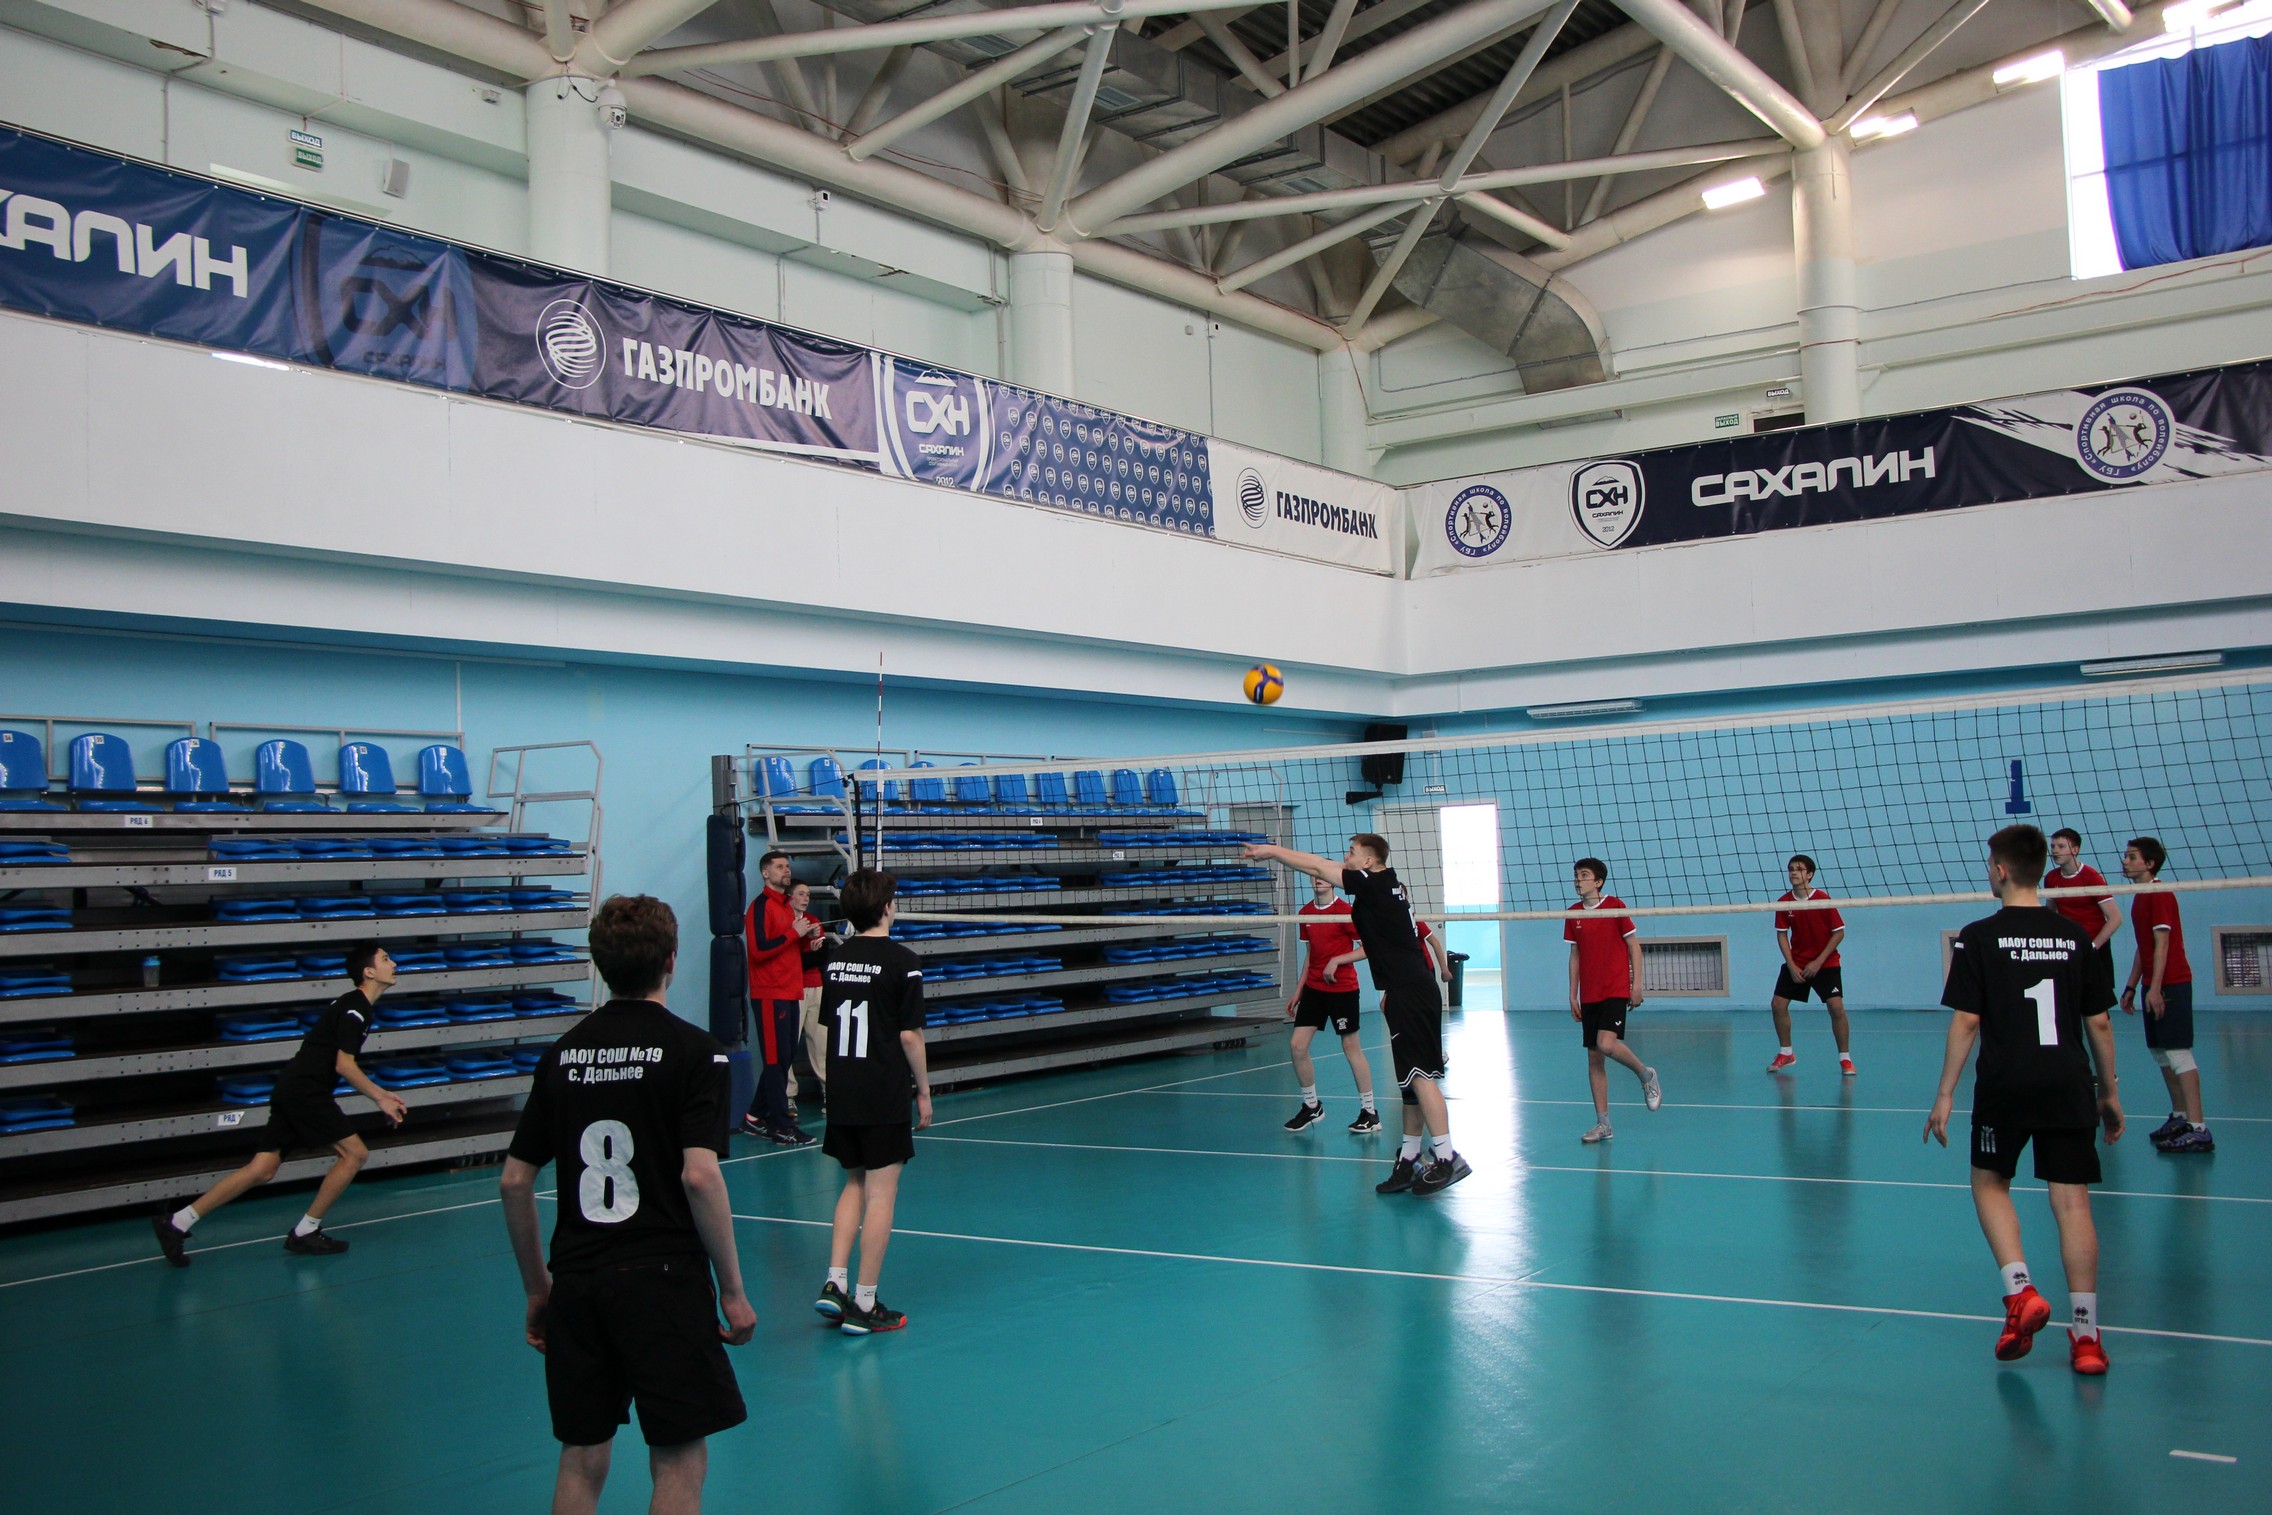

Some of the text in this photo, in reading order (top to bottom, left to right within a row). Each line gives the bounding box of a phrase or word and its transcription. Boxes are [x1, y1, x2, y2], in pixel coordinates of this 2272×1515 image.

[291, 131, 321, 147] ВЫХОД
[0, 189, 248, 298] АЛИН
[623, 337, 832, 420] ГАЗПРОМБАНК
[1767, 388, 1789, 397] ВЫХОД
[906, 390, 971, 436] СХН
[1715, 418, 1738, 427] ВЫХОД
[2099, 465, 2120, 476] ГБУ
[2111, 395, 2145, 404] школа
[2148, 404, 2159, 415] по
[919, 444, 965, 457] САХАЛИН
[1691, 445, 1936, 507] САХАЛИН
[1586, 485, 1629, 510] СХН
[1276, 491, 1378, 540] ГАЗПРОМБАНК
[1460, 546, 1476, 556] ГБУ
[1469, 487, 1494, 496] школа
[1496, 495, 1505, 505] по
[1592, 510, 1624, 518] САХАЛИН
[130, 817, 142, 825] РЯД
[214, 869, 232, 877] РЯД 5
[1998, 937, 2076, 951] МАОУ СОШ №19
[2010, 949, 2069, 961] с. Дальнее
[846, 962, 864, 973] СОШ
[830, 972, 872, 983] с. Дальнее
[2024, 978, 2059, 1045] 1
[836, 999, 869, 1058] 11
[560, 1046, 663, 1066] МАОУ СОШ №19
[568, 1065, 644, 1084] с. Дальнее
[224, 1113, 236, 1123] РЯД
[579, 1119, 640, 1224] 8
